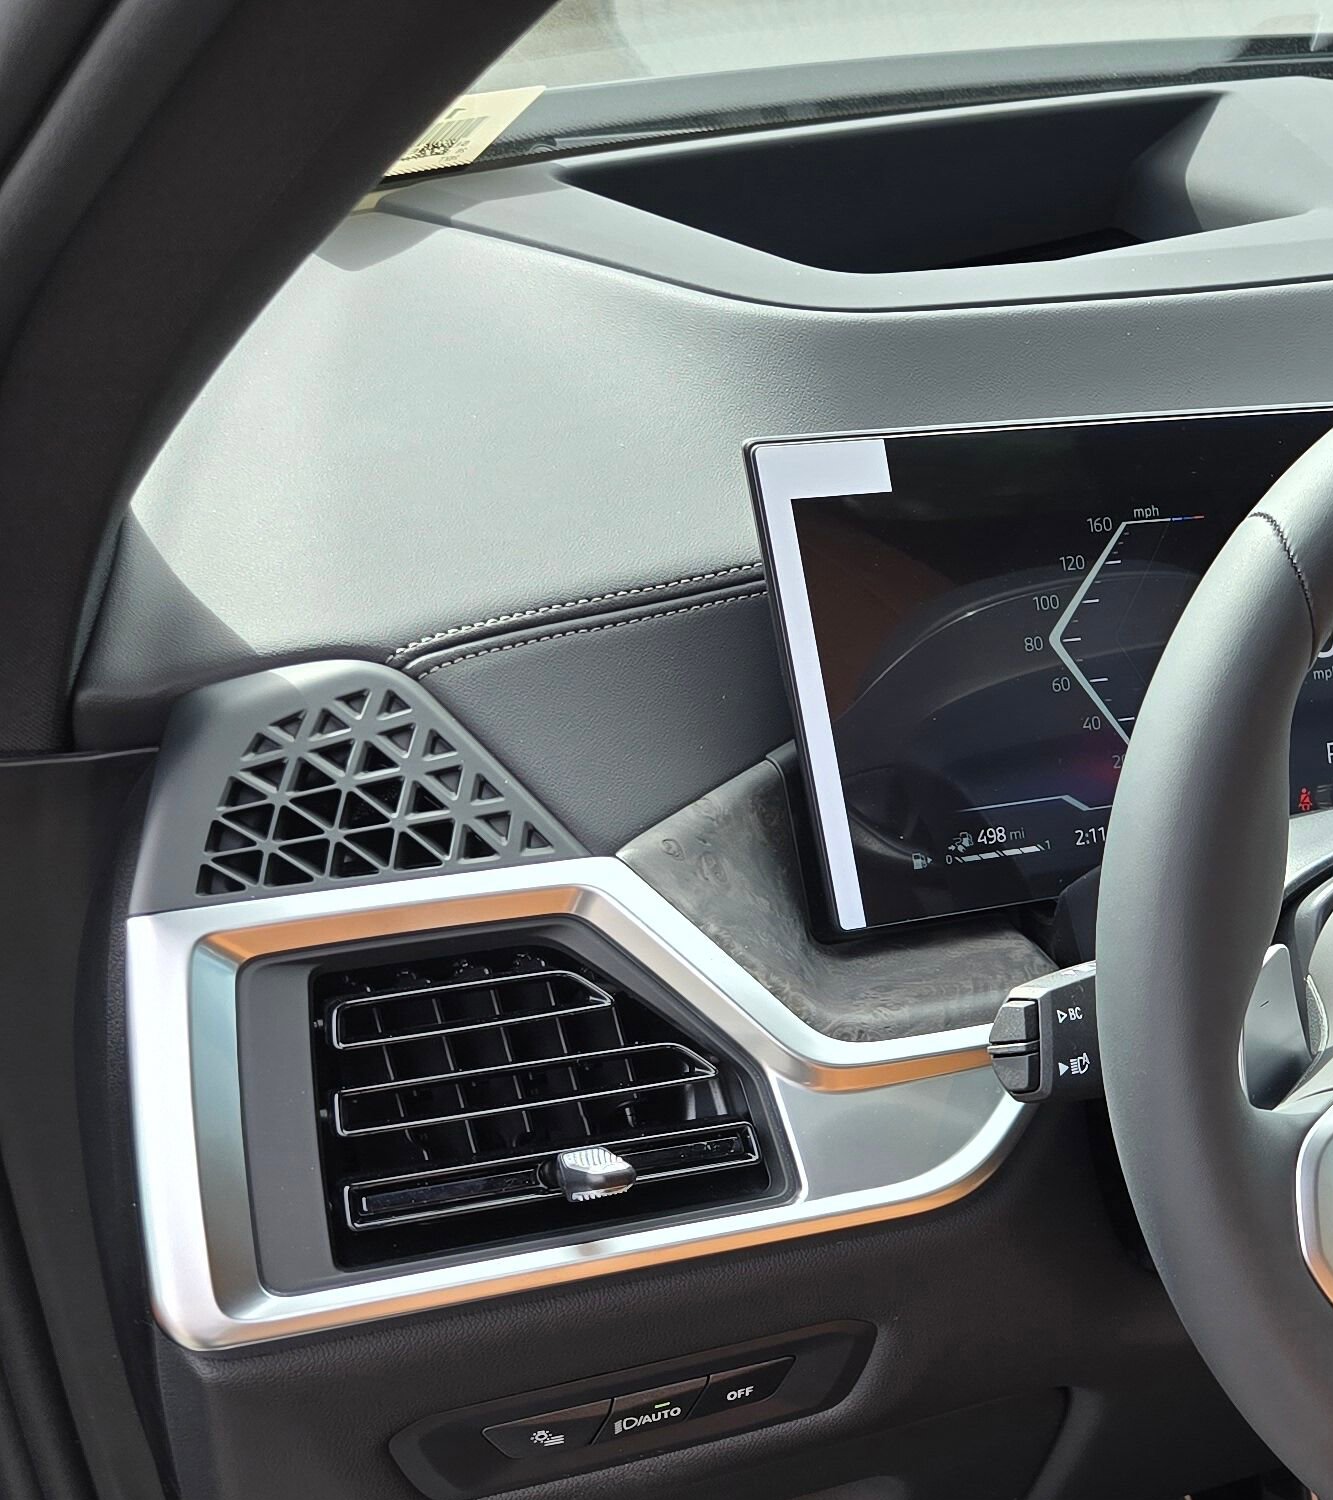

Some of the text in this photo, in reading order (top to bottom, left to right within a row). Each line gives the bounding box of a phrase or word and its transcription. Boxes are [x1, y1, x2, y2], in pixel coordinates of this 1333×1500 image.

[1133, 505, 1159, 519] mph
[1086, 516, 1113, 533] 160
[1059, 555, 1085, 571] 120
[1032, 594, 1060, 611] 100
[1024, 636, 1044, 652] 80
[1052, 676, 1071, 693] 60
[1082, 716, 1101, 731] 40
[1111, 754, 1126, 769] 2
[976, 826, 1025, 845] 498 mi
[1074, 827, 1106, 846] 2:11
[945, 855, 953, 865] 0
[1068, 1006, 1083, 1021] BC
[726, 1385, 754, 1401] OFF
